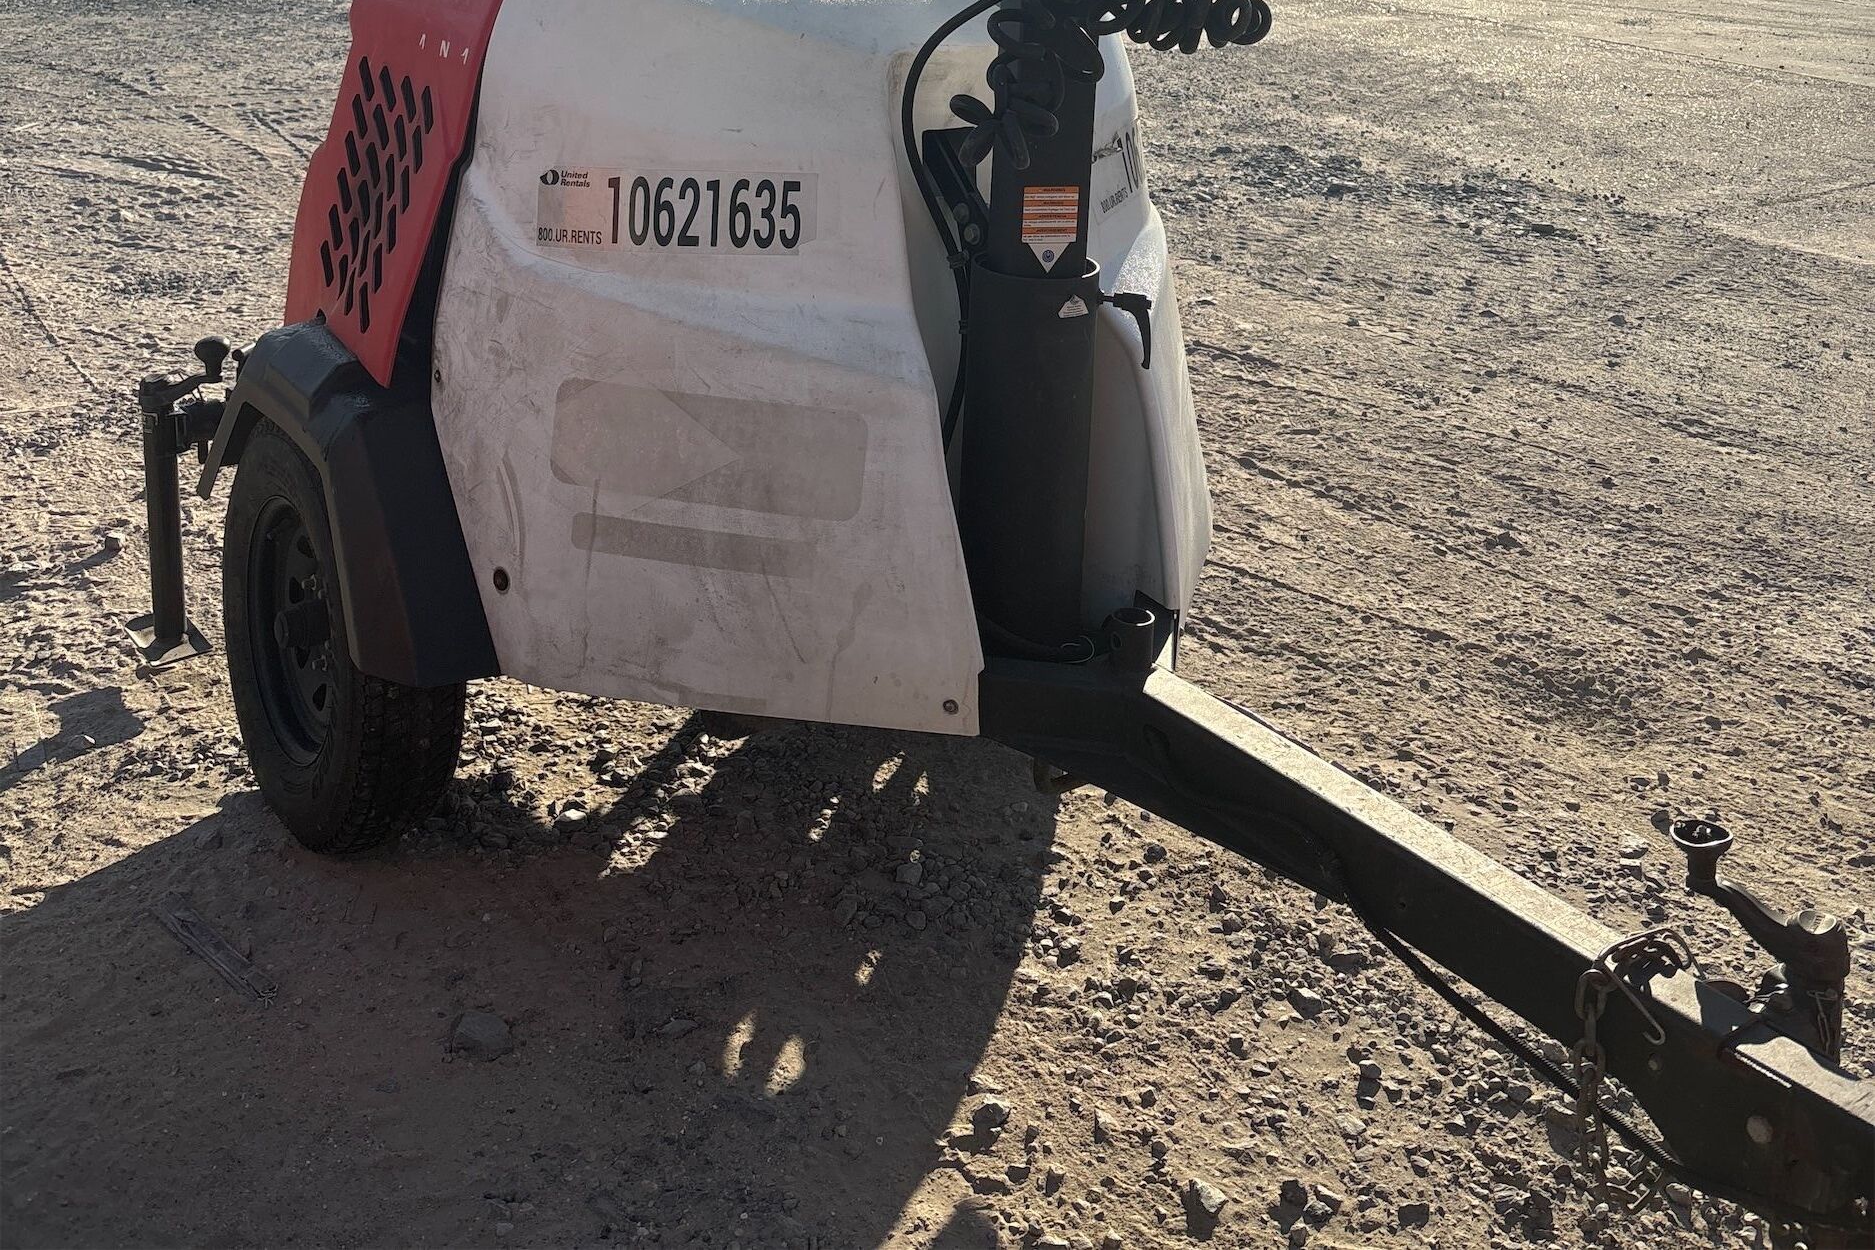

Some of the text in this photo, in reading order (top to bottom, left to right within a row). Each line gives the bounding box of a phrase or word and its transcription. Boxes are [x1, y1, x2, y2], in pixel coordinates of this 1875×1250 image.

[561, 170, 588, 179] United
[560, 179, 590, 188] Rentals
[607, 176, 801, 249] 10621635
[537, 227, 602, 245] 800.UR.RENTS
